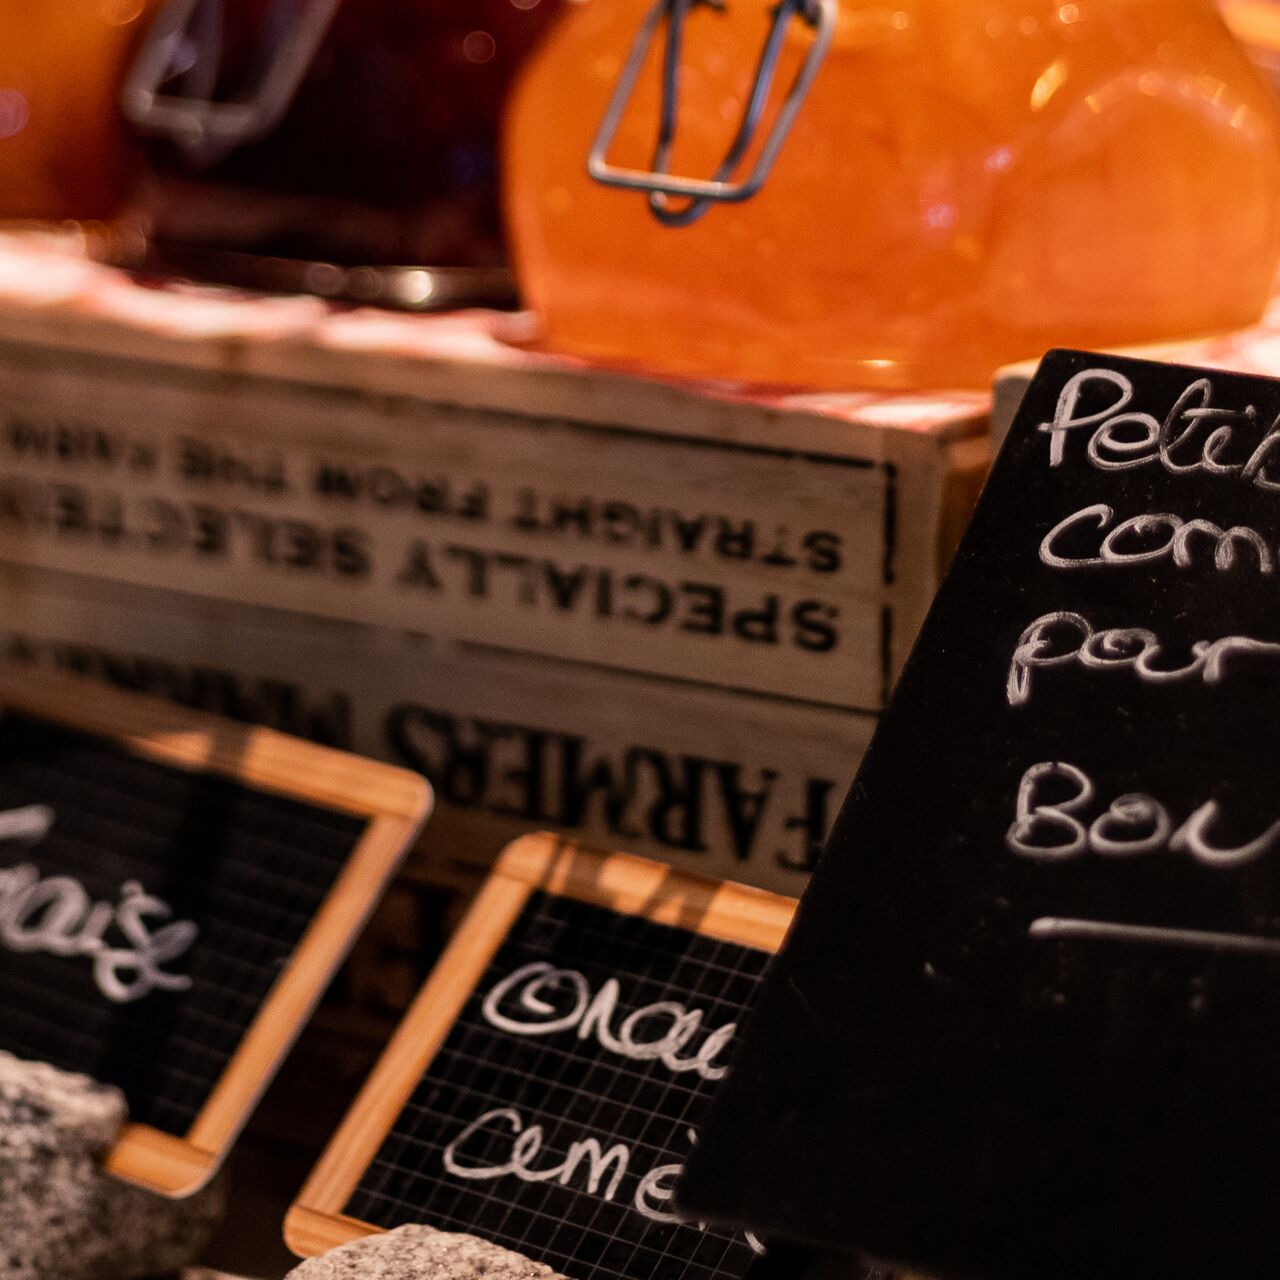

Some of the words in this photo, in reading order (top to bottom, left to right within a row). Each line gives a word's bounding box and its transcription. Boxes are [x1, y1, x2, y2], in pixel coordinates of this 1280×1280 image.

[314, 462, 490, 521] FROM
[512, 487, 843, 574] STRAIGHT
[394, 538, 842, 653] SPECIALLY
[388, 700, 837, 874] FARMERS
